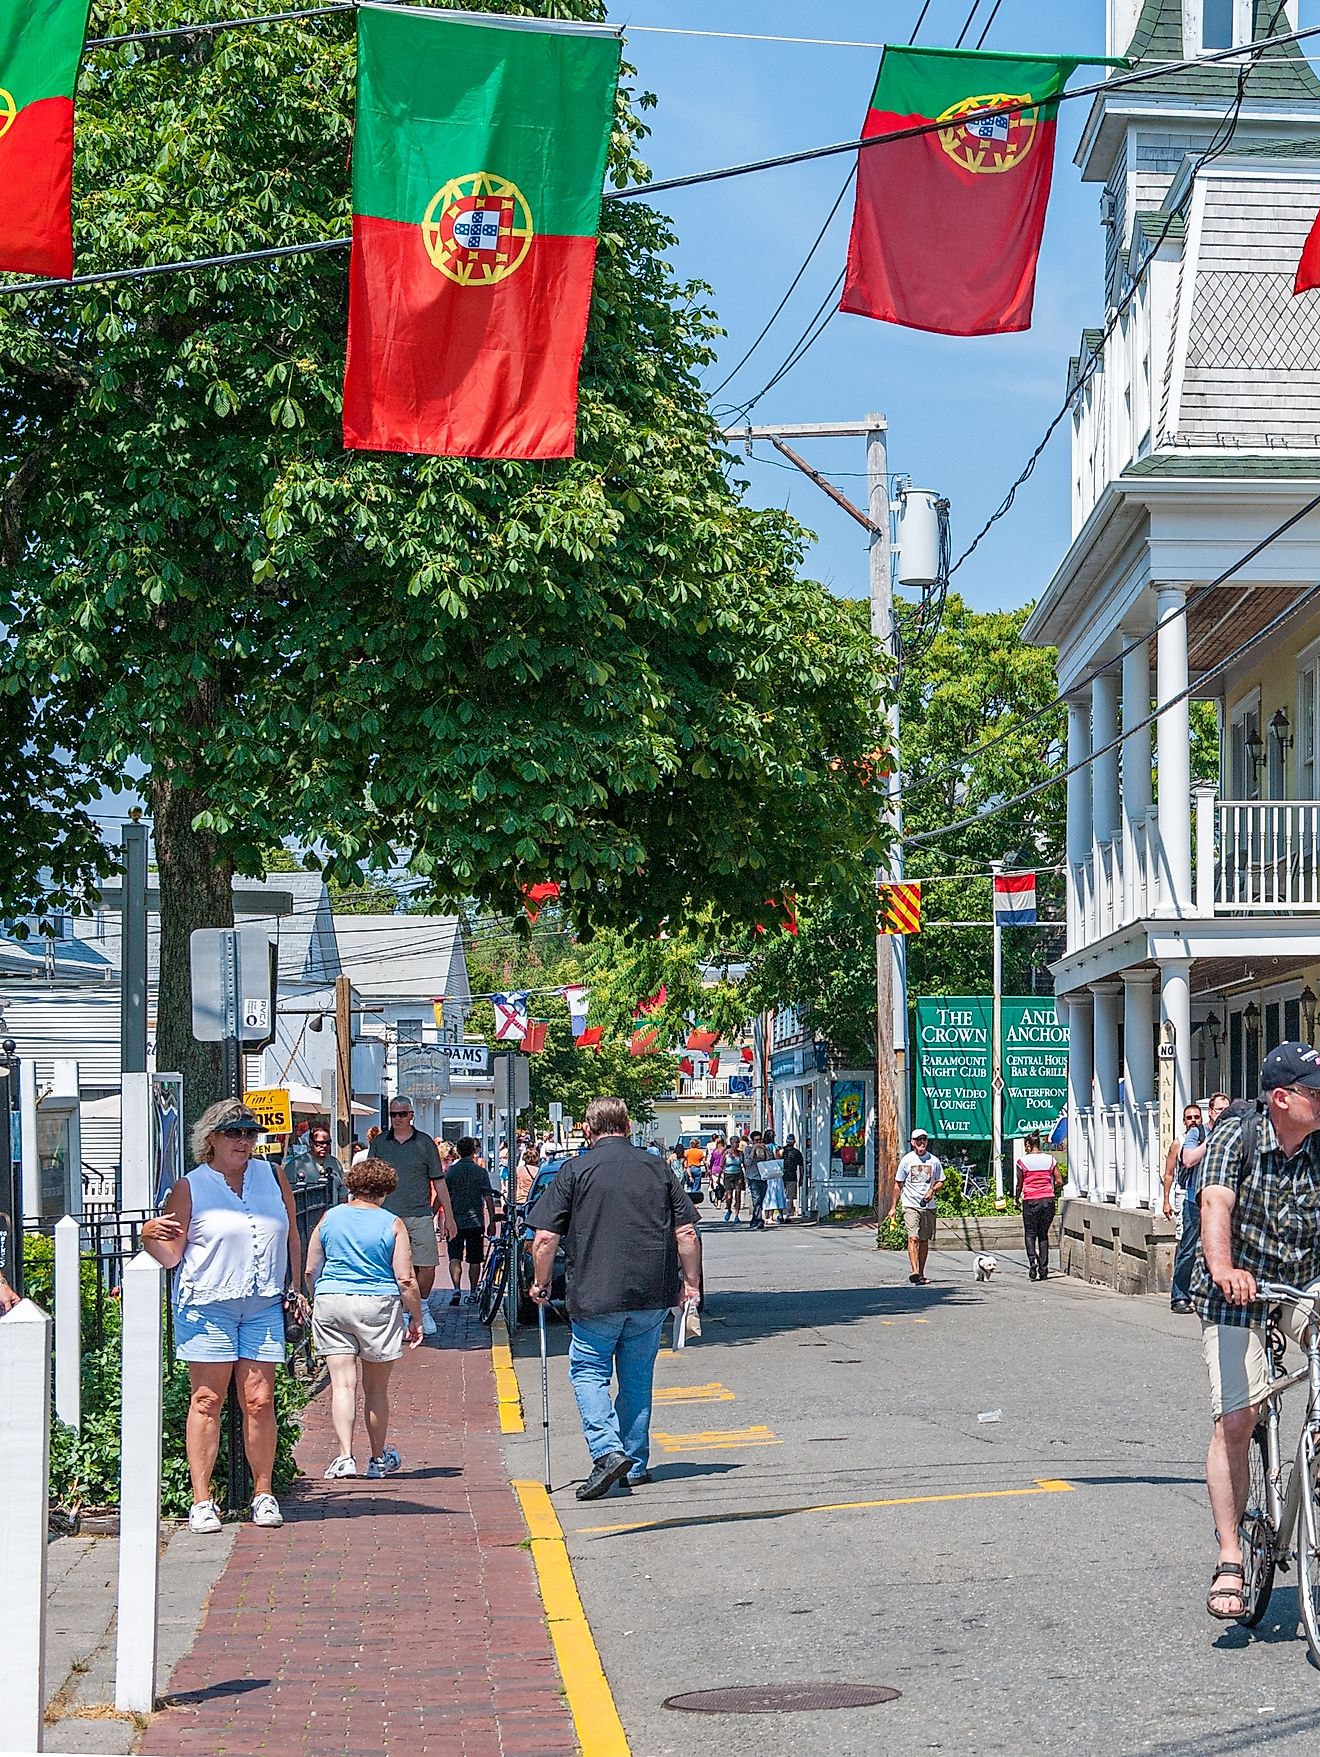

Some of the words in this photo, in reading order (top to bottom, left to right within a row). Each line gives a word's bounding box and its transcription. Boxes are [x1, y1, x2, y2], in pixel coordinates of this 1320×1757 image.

[936, 1009, 973, 1026] THE
[1020, 1008, 1059, 1026] AND
[921, 1026, 988, 1043] CROWN
[1006, 1026, 1071, 1042] ANCHOR
[1161, 1045, 1174, 1056] NO
[922, 1055, 987, 1066] PARAMOUNT
[1006, 1055, 1043, 1066] CENTRAL
[1044, 1055, 1068, 1066] HOUS
[922, 1066, 957, 1077] NIGHT
[959, 1066, 987, 1078] CLUB
[1011, 1066, 1027, 1077] BAR
[1030, 1066, 1037, 1077] &
[243, 1091, 275, 1105] Tim's
[922, 1087, 951, 1098] WAVE
[954, 1088, 987, 1099] VIDEO
[933, 1099, 976, 1110] LOUNGE
[1026, 1098, 1053, 1109] POOL
[256, 1113, 285, 1126] OKS
[939, 1119, 970, 1130] VAULT
